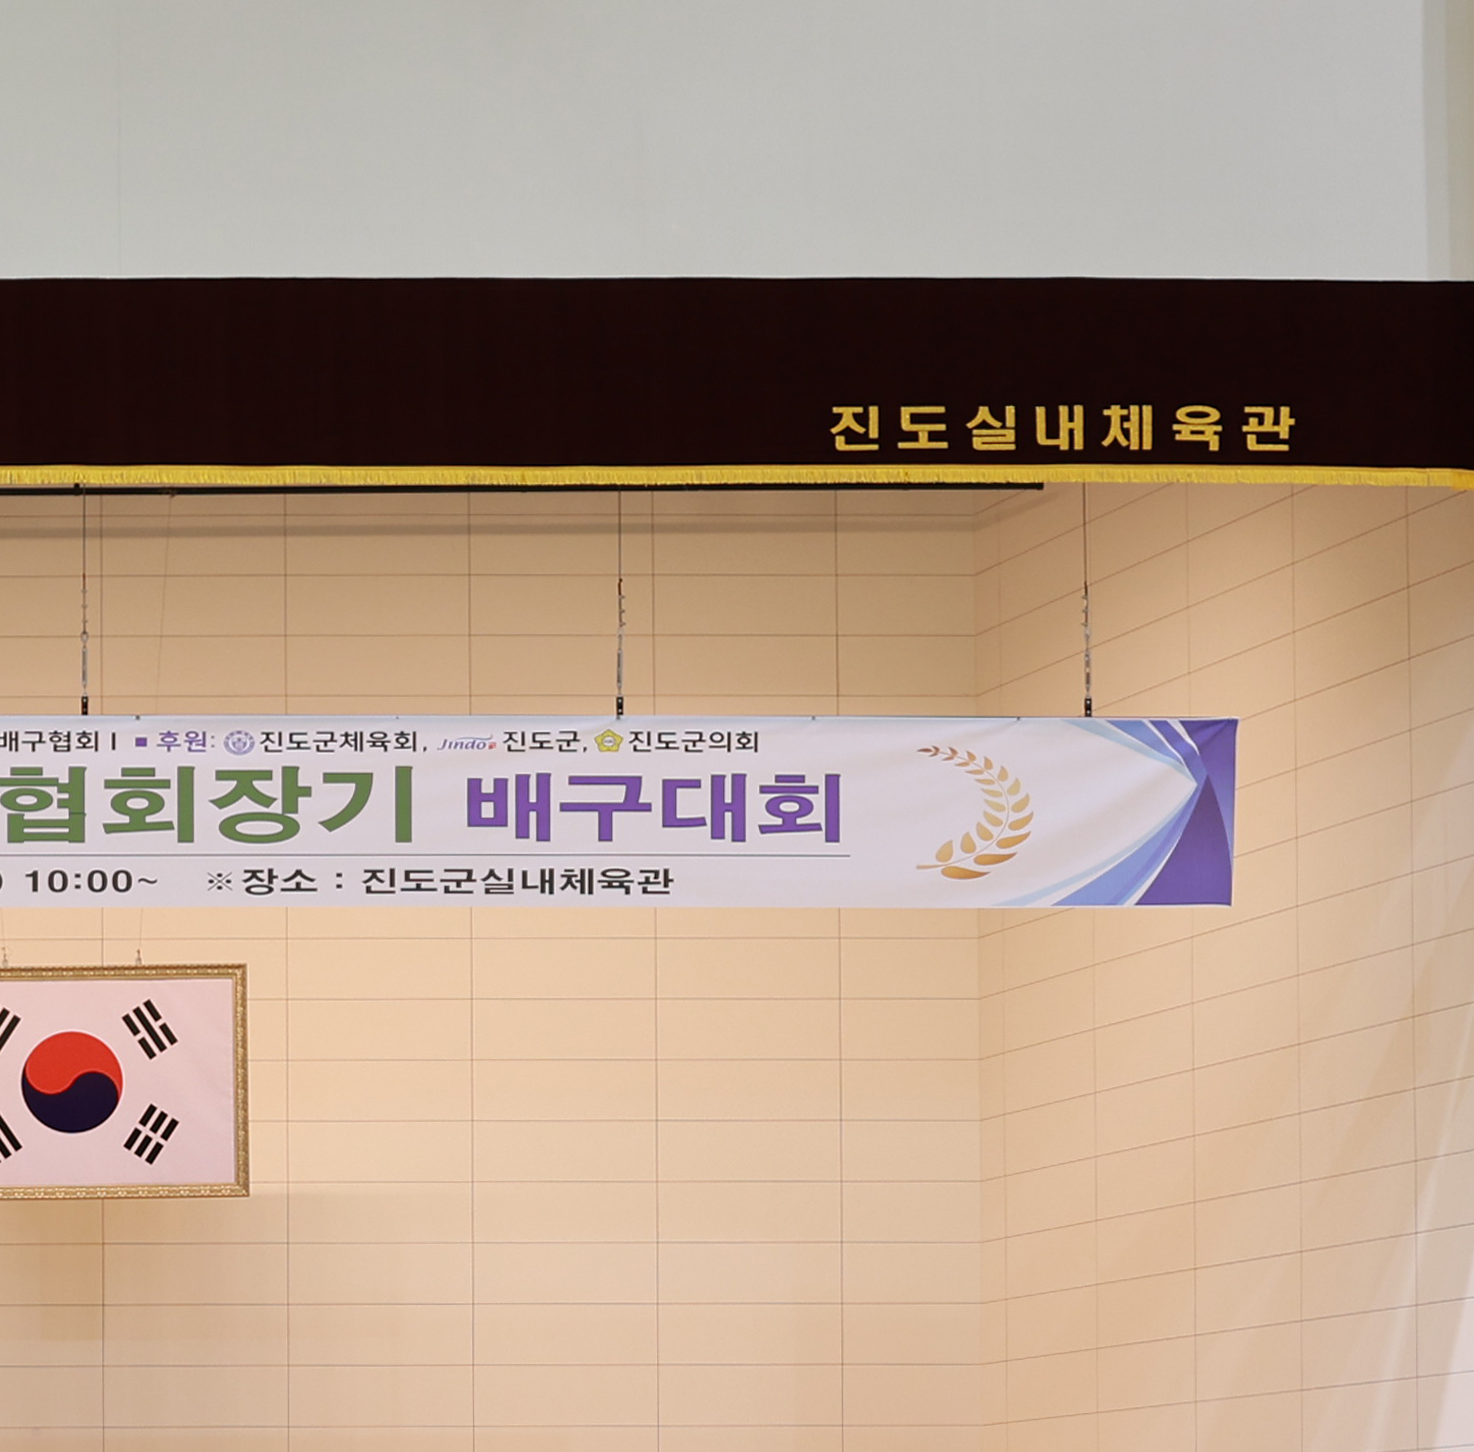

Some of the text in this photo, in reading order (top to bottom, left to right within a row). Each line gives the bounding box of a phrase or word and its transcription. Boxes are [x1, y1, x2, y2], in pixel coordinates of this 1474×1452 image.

[829, 404, 1297, 453] 진도실내체육관
[258, 729, 428, 754] 진도군체육회,
[502, 728, 589, 754] 진도군,
[628, 730, 759, 754] 진도군의회
[466, 771, 842, 844] 배구대회
[24, 869, 159, 894] 10:00~
[361, 867, 675, 896] 진도군실내체육관
